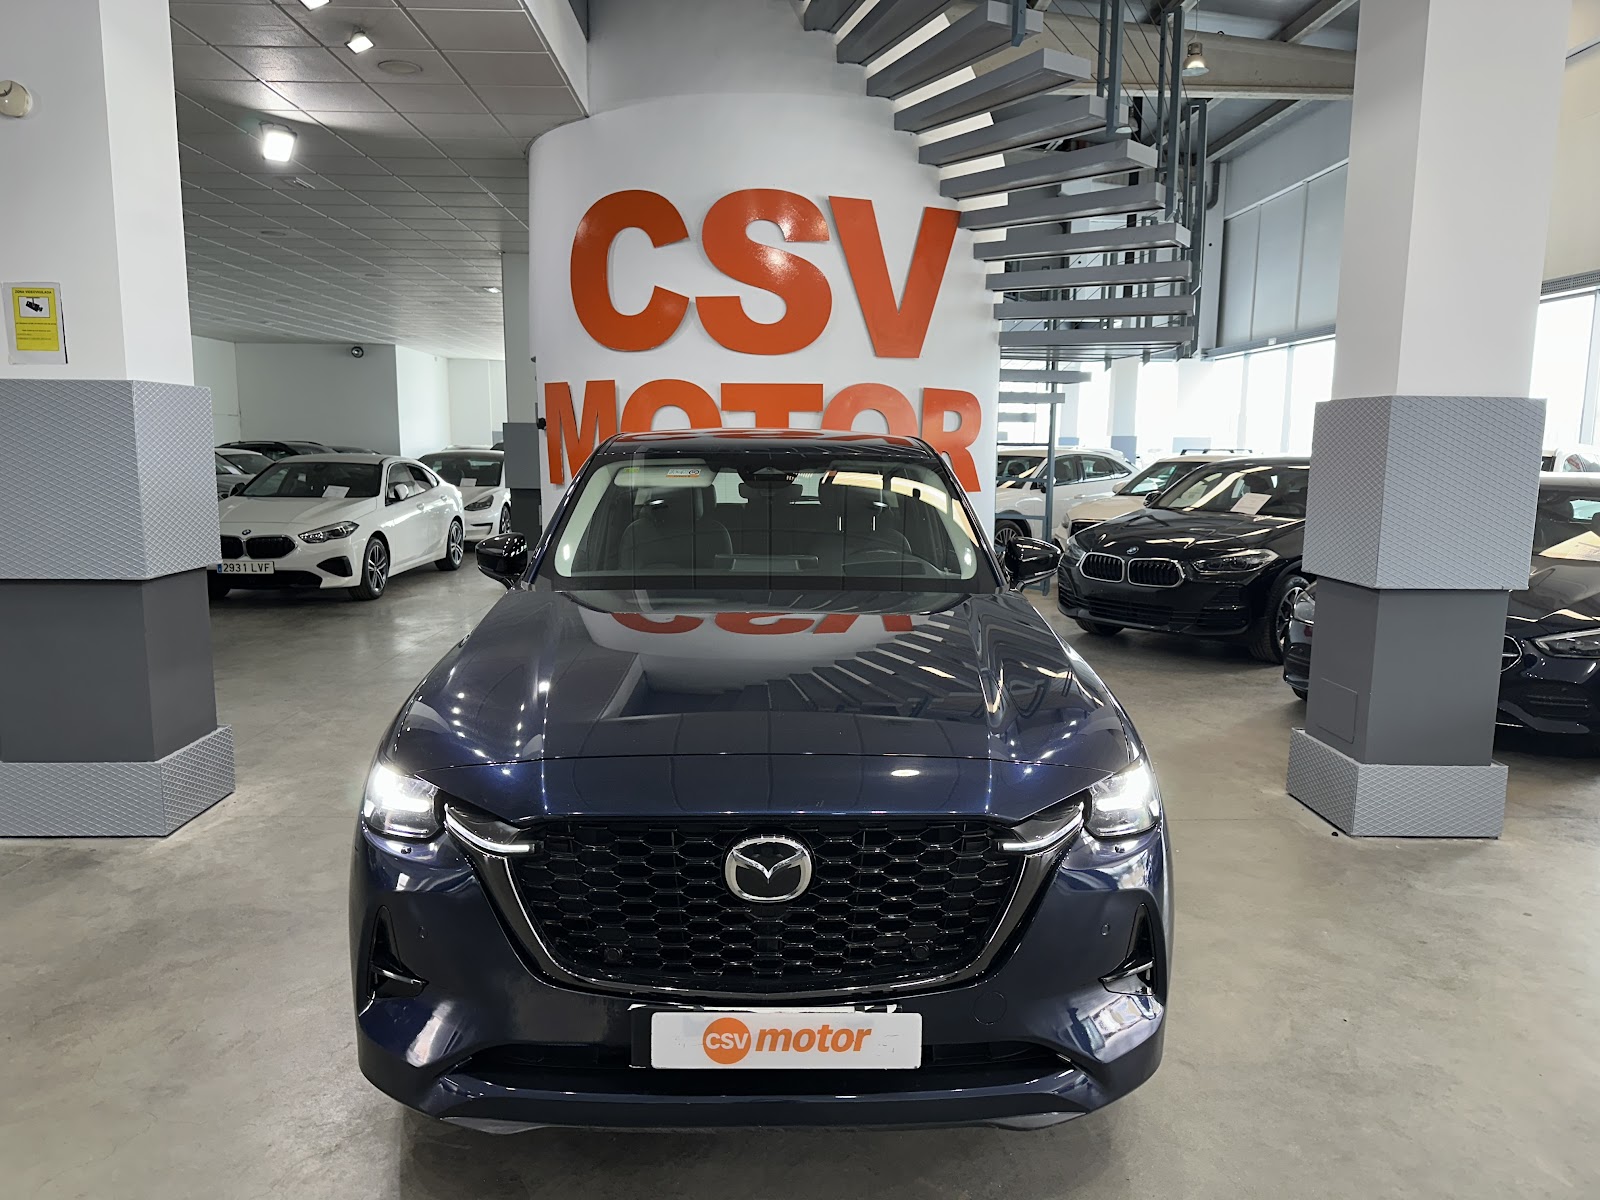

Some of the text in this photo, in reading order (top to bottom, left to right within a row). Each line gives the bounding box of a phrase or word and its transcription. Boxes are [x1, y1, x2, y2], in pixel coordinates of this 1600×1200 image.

[570, 188, 962, 358] CSV
[223, 562, 270, 573] 2931 LVF
[755, 1024, 872, 1052] motor
